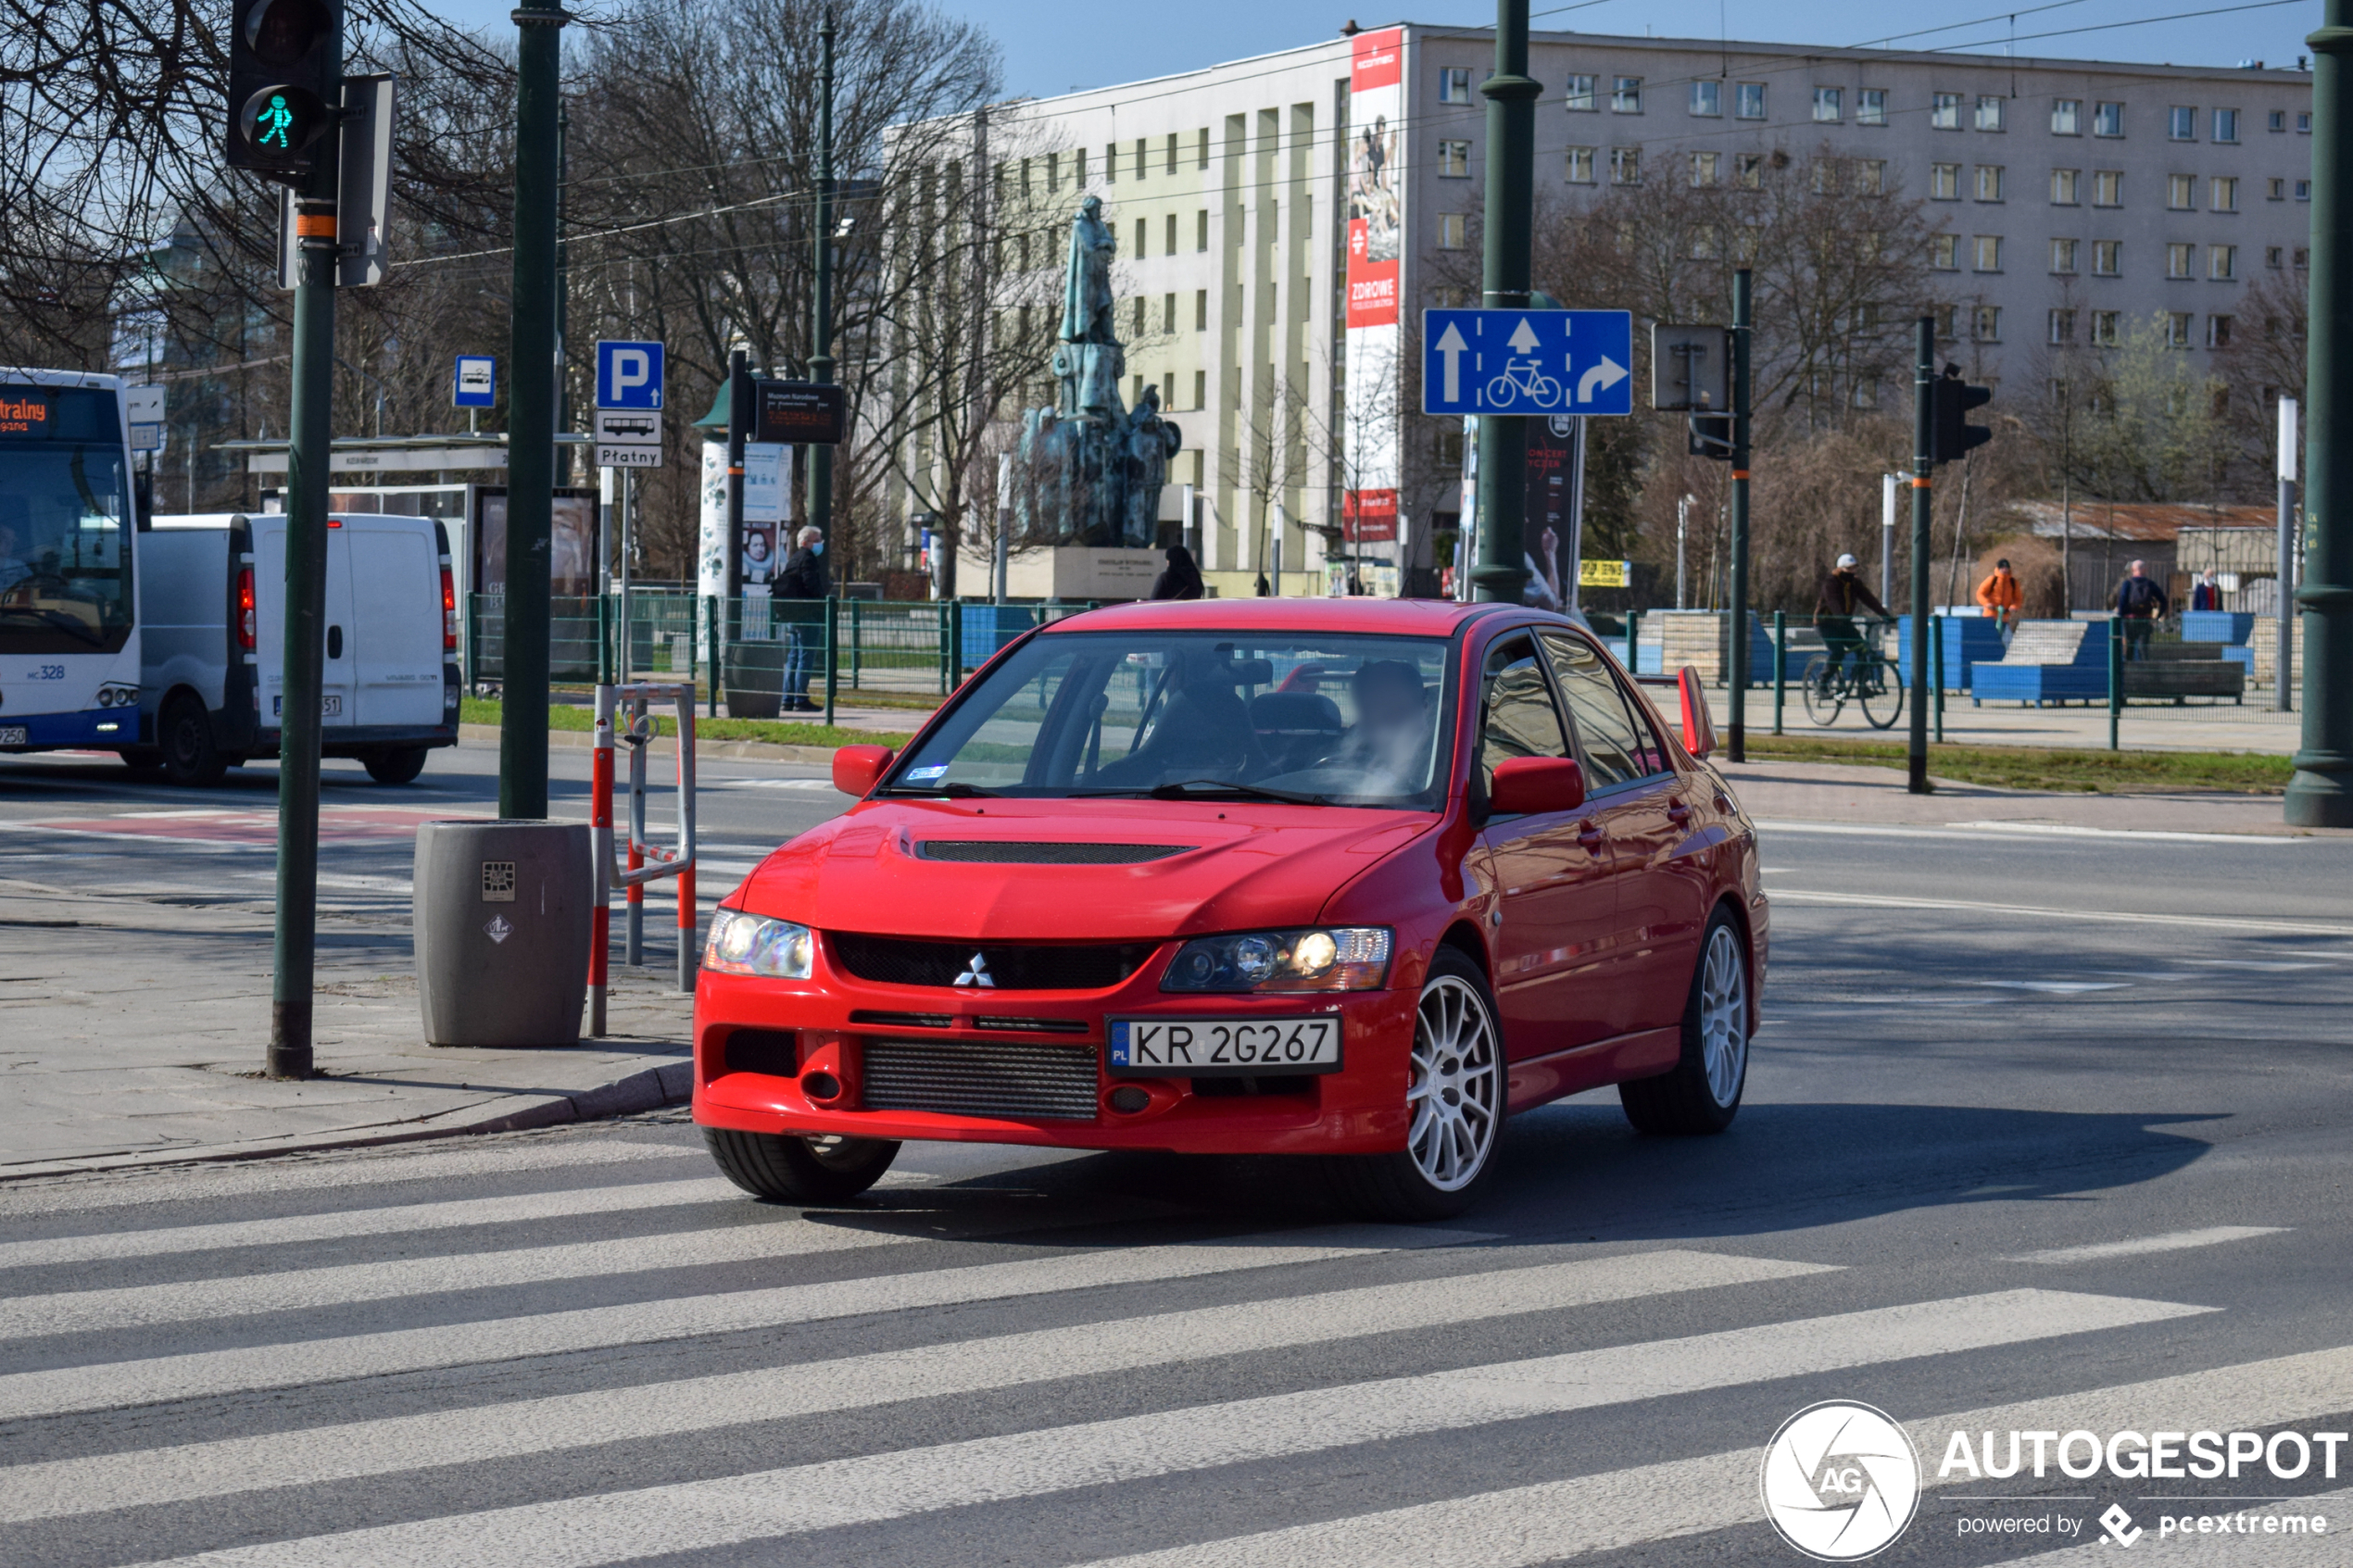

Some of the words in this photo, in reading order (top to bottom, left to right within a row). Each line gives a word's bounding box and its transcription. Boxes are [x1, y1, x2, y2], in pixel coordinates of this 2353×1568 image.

[1352, 278, 1394, 301] ZDROWE
[611, 348, 648, 401] P
[602, 449, 657, 466] Płatny
[1528, 448, 1567, 458] ONCERT
[1138, 1026, 1194, 1063] KR
[1211, 1023, 1328, 1063] 2G267
[1114, 1050, 1127, 1061] PL
